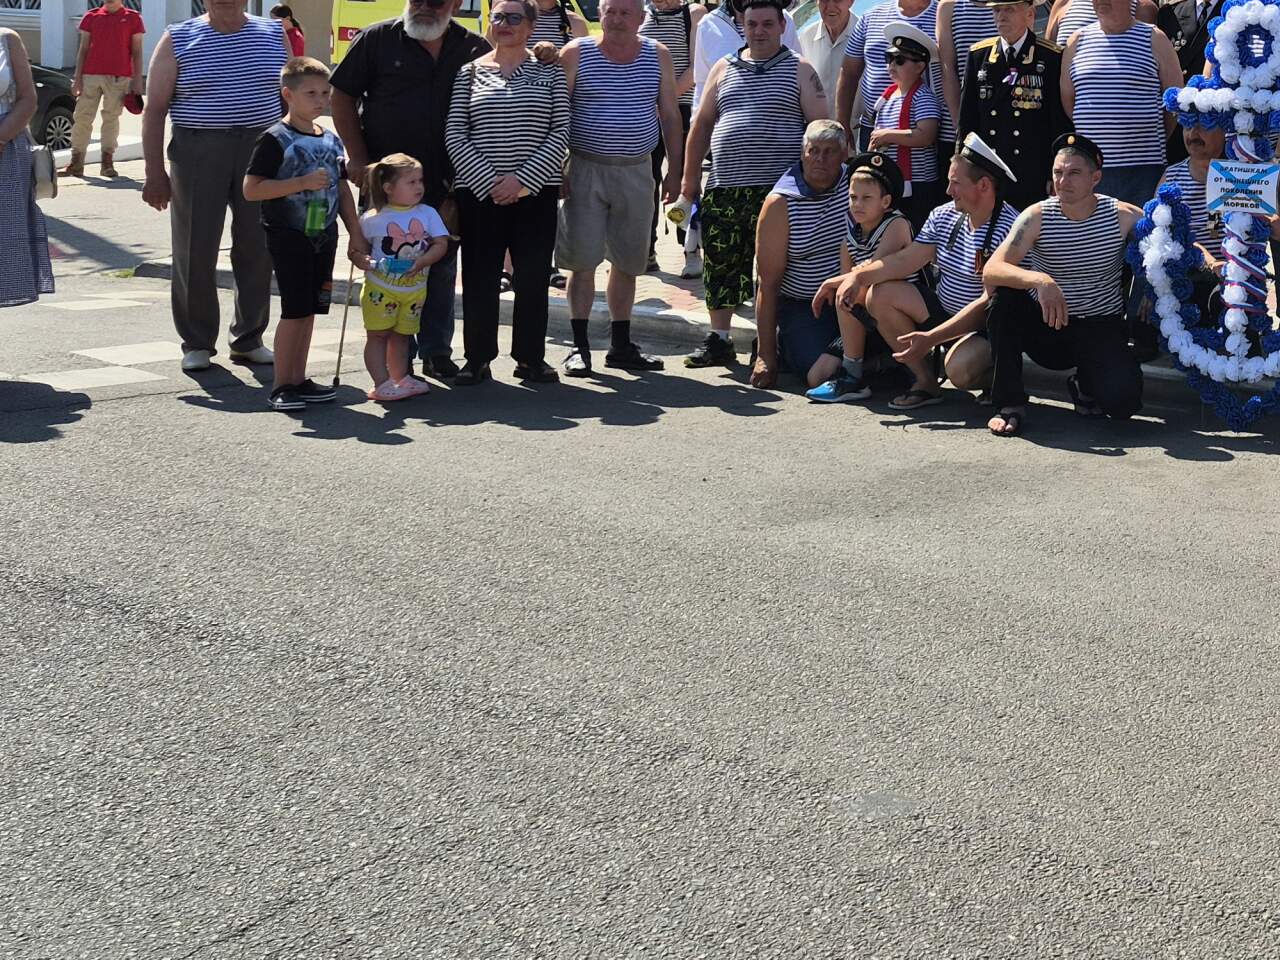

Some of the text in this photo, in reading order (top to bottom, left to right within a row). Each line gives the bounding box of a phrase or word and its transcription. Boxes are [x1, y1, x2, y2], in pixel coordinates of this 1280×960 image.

[1220, 166, 1268, 174] БРАТИШКАМ
[1220, 187, 1263, 195] ПОКОЛЕНИЯ
[1223, 201, 1260, 209] МОРЯКОВ
